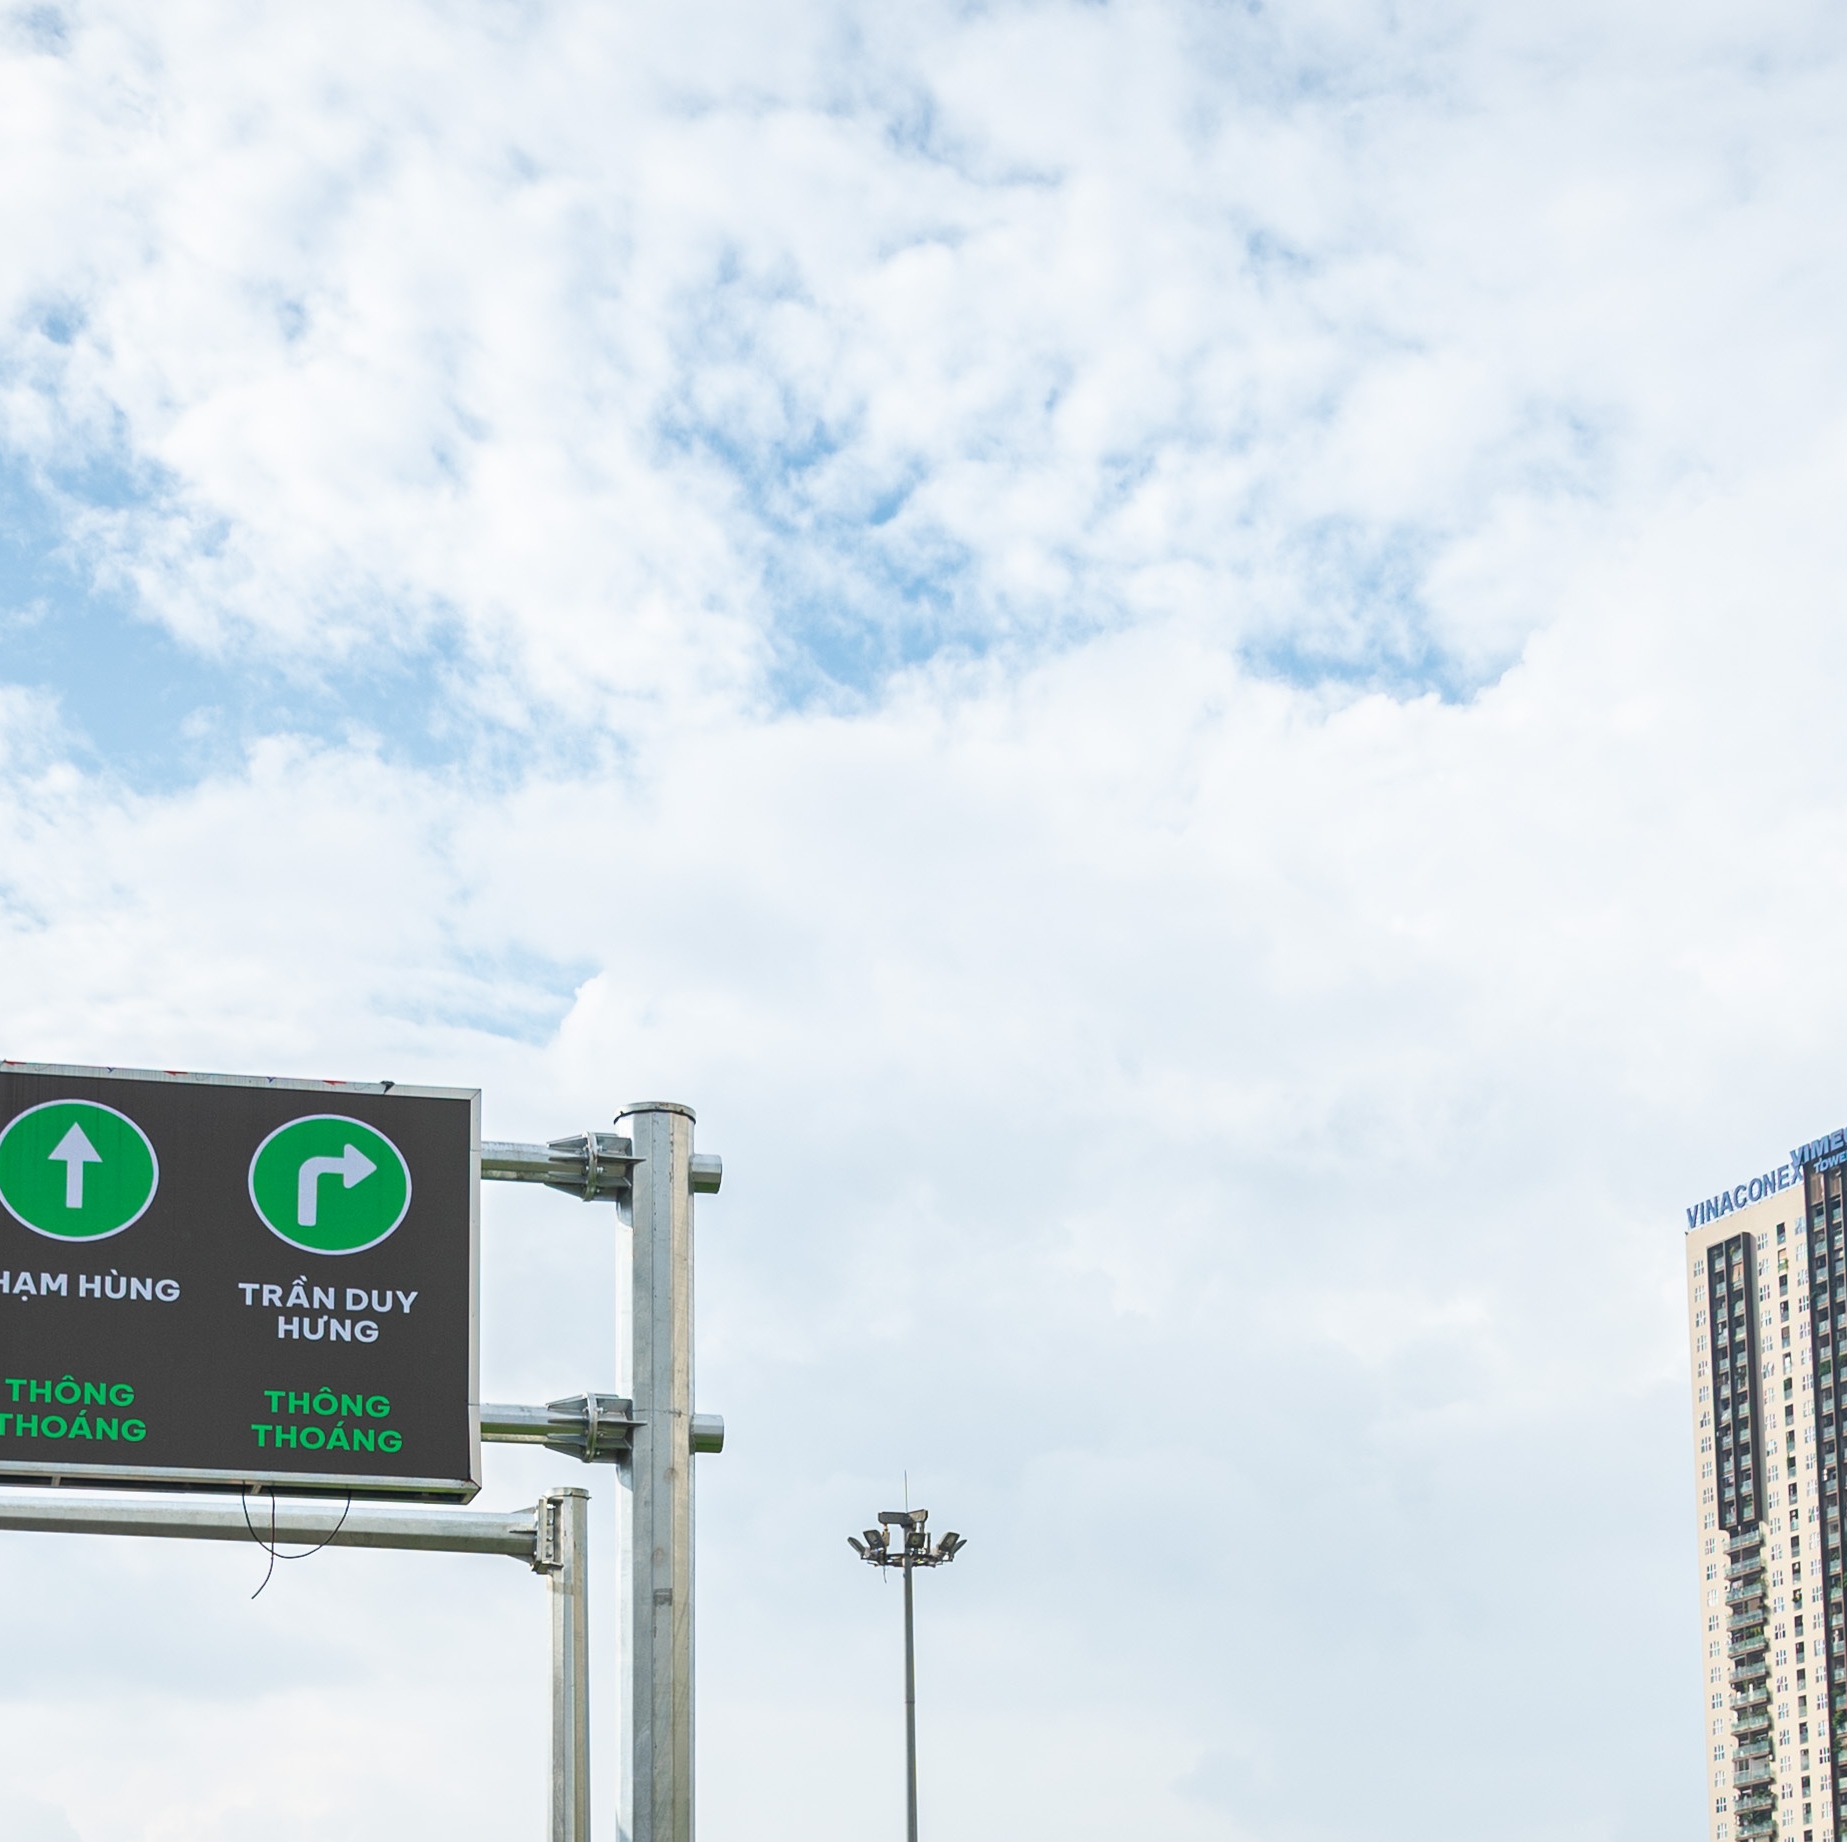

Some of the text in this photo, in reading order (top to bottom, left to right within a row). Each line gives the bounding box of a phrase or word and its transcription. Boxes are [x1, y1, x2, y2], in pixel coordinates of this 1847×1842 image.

[1686, 1162, 1804, 1229] VINACONEX
[79, 1269, 181, 1302] HÙNG
[238, 1275, 418, 1313] TRẦN DUY
[278, 1315, 379, 1343] HƯNG
[5, 1374, 135, 1406] THÔNG
[264, 1387, 391, 1418] THÔNG
[251, 1420, 402, 1453] THOÁNG
